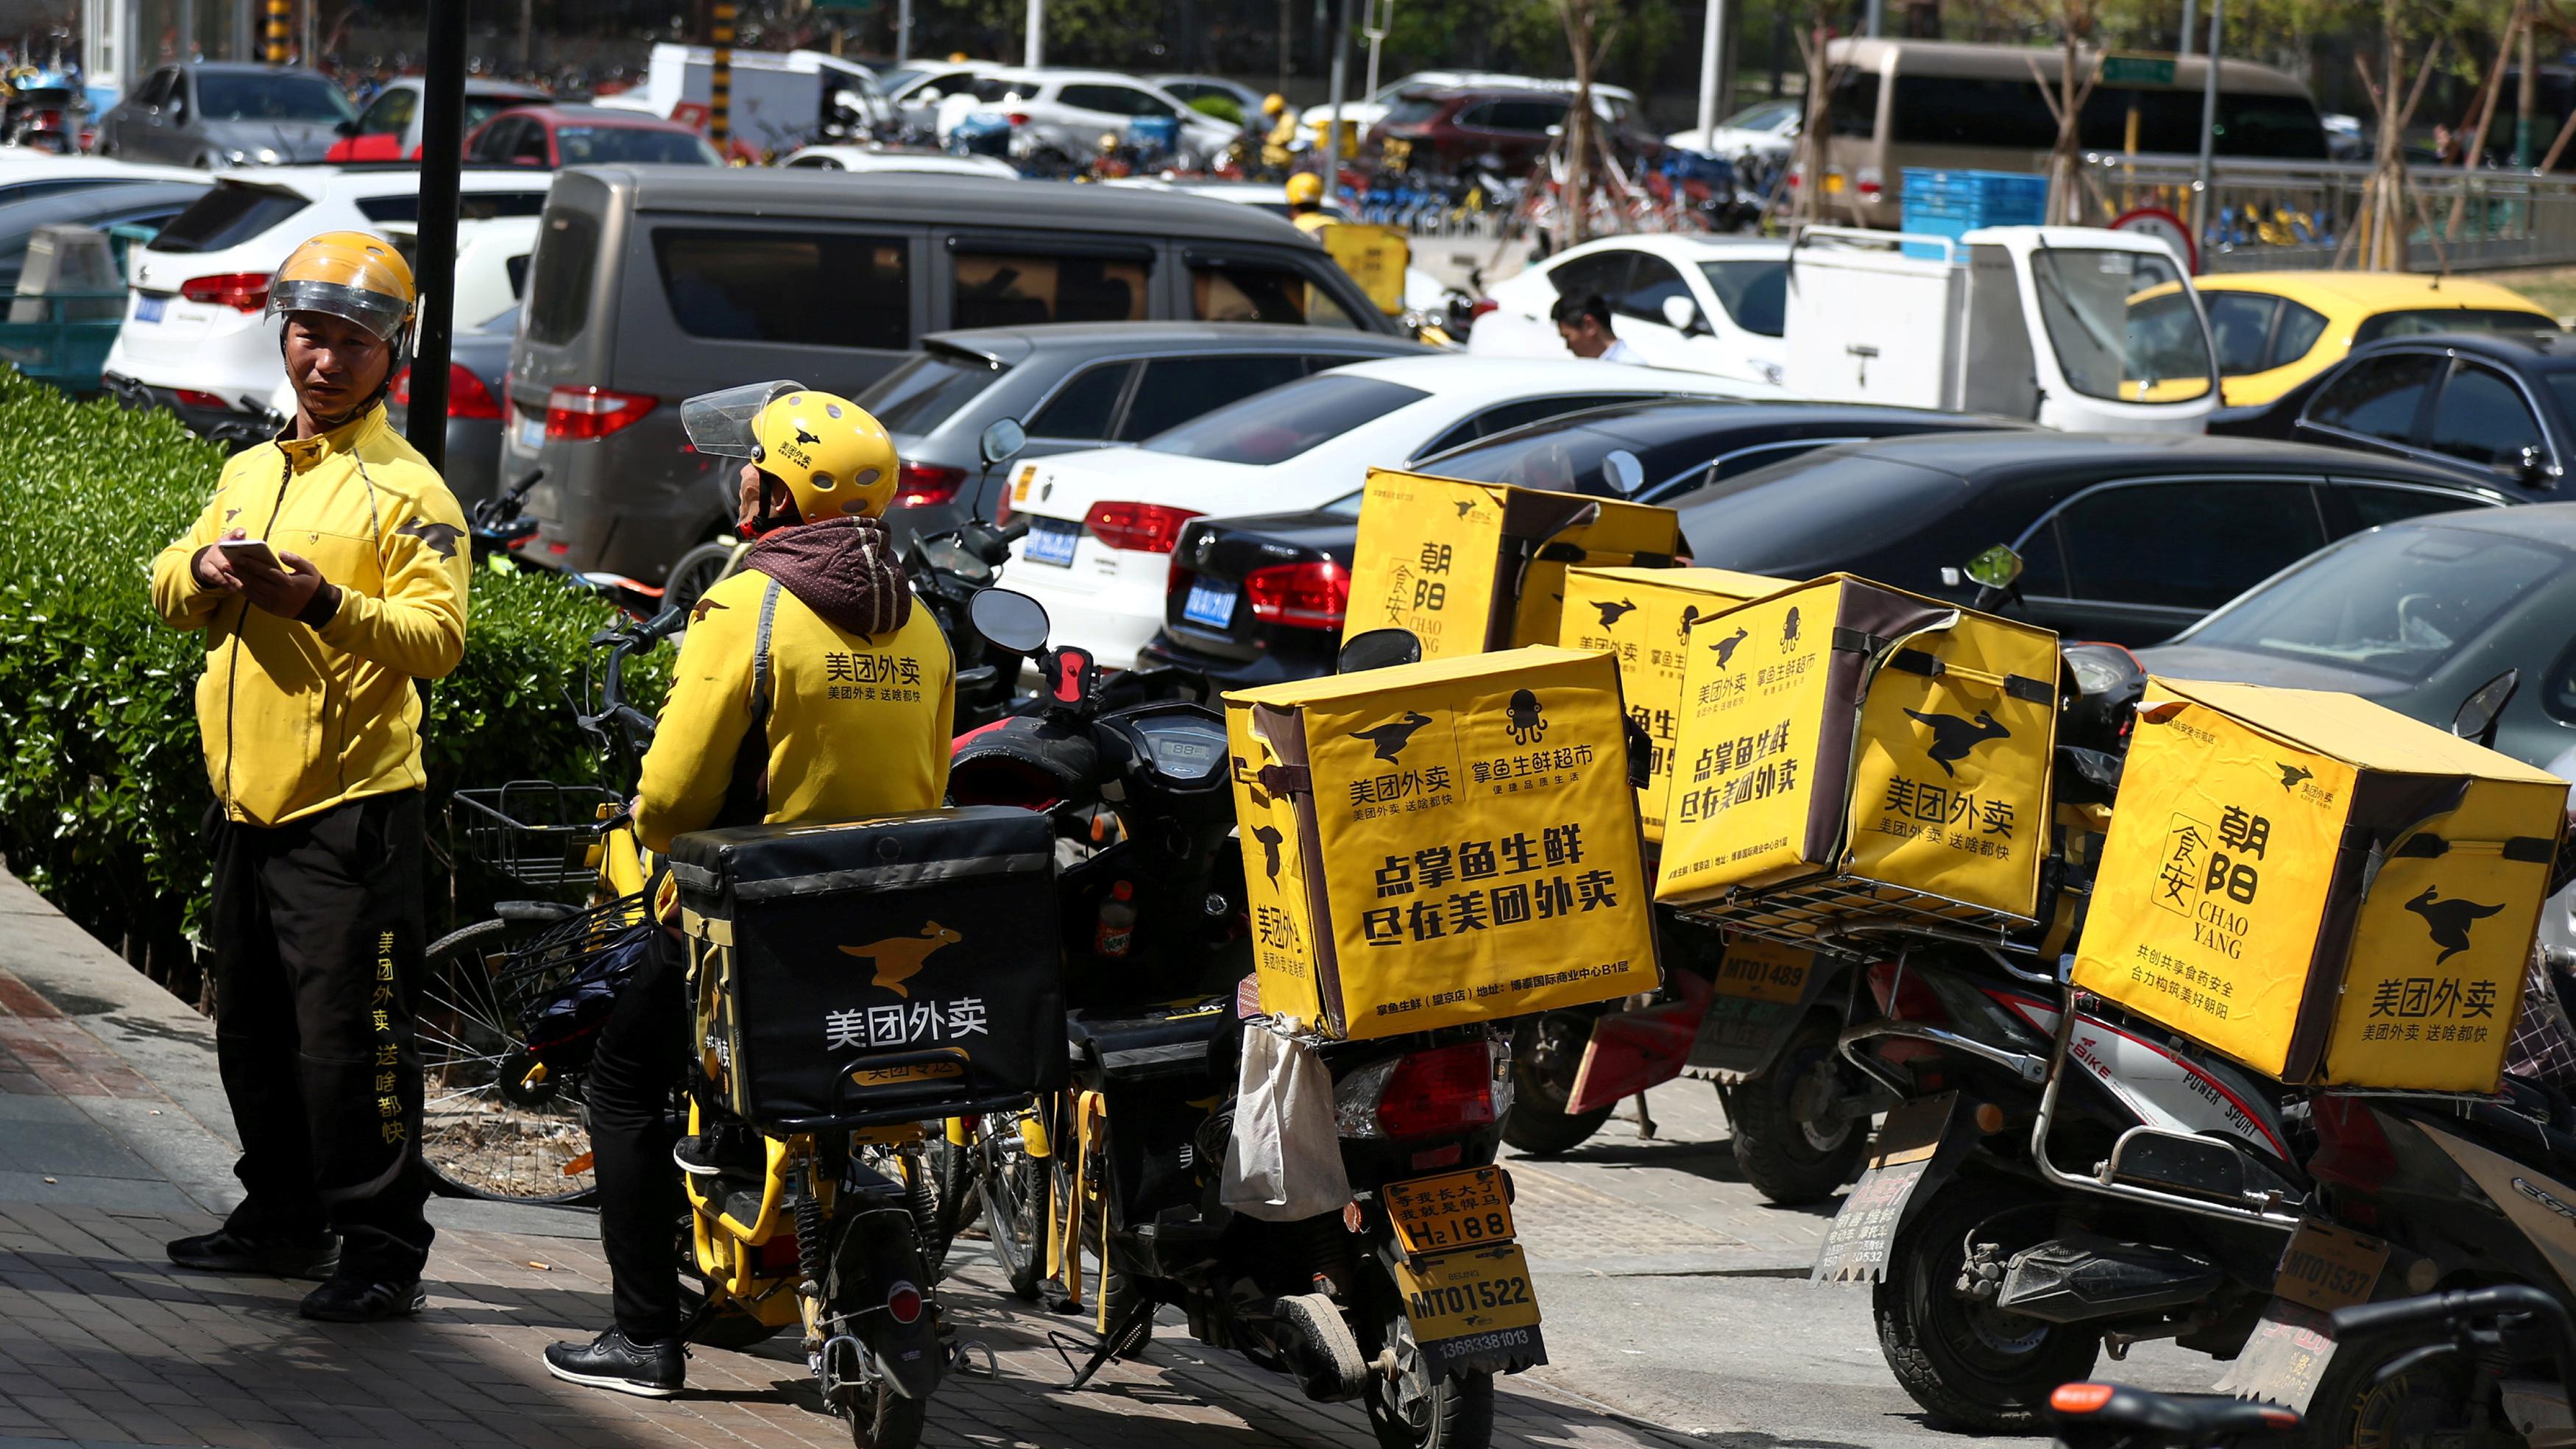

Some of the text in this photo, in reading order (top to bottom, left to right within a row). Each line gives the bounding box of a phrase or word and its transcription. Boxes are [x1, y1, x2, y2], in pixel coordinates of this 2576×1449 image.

[1413, 541, 1452, 612] 朝阳
[1409, 615, 1442, 635] CHAO
[1422, 637, 1440, 653] NG
[825, 652, 920, 686] 美团外卖
[1697, 673, 1747, 706] 美团外卖
[828, 686, 921, 703] 美团外卖 送啥都快
[1471, 743, 1593, 784] 掌鱼生鲜超市
[1693, 718, 1790, 783] 点掌鱼生鲜
[1349, 765, 1451, 807] 美团外卖
[1680, 758, 1797, 823] 尽在美团外卖
[1353, 793, 1453, 822] 美团外卖 送啥都快
[1884, 775, 2014, 840] 美团外卖
[1879, 817, 2009, 861] 美团外卖 送啥都快
[2203, 805, 2271, 905] 朝阳
[1375, 823, 1584, 899] 点掌鱼生鲜
[1362, 869, 1618, 947] 尽在美团外卖
[2198, 901, 2248, 938] CHAO
[2193, 921, 2243, 960] YANG
[1723, 958, 1805, 987] MT01489
[2136, 943, 2234, 999] 共创共享食药安全
[2131, 966, 2229, 1021] 合力构筑美好朝阳
[2368, 977, 2497, 1018] 美团外卖
[372, 931, 406, 1144] 美团外卖 送啥都快
[826, 997, 988, 1051] 美团外卖
[2361, 1023, 2488, 1043] 美团外卖 送啥都快
[2182, 1071, 2222, 1105] POWER
[2225, 1103, 2258, 1138] SPORT
[1396, 1180, 1496, 1208] 等我长大了
[1401, 1194, 1501, 1221] 我就是悍马
[1448, 1269, 1479, 1280] BEIJING
[2285, 1250, 2371, 1297] MT01537
[1410, 1277, 1529, 1319] MT01522
[1440, 1329, 1529, 1359] 13683381013
